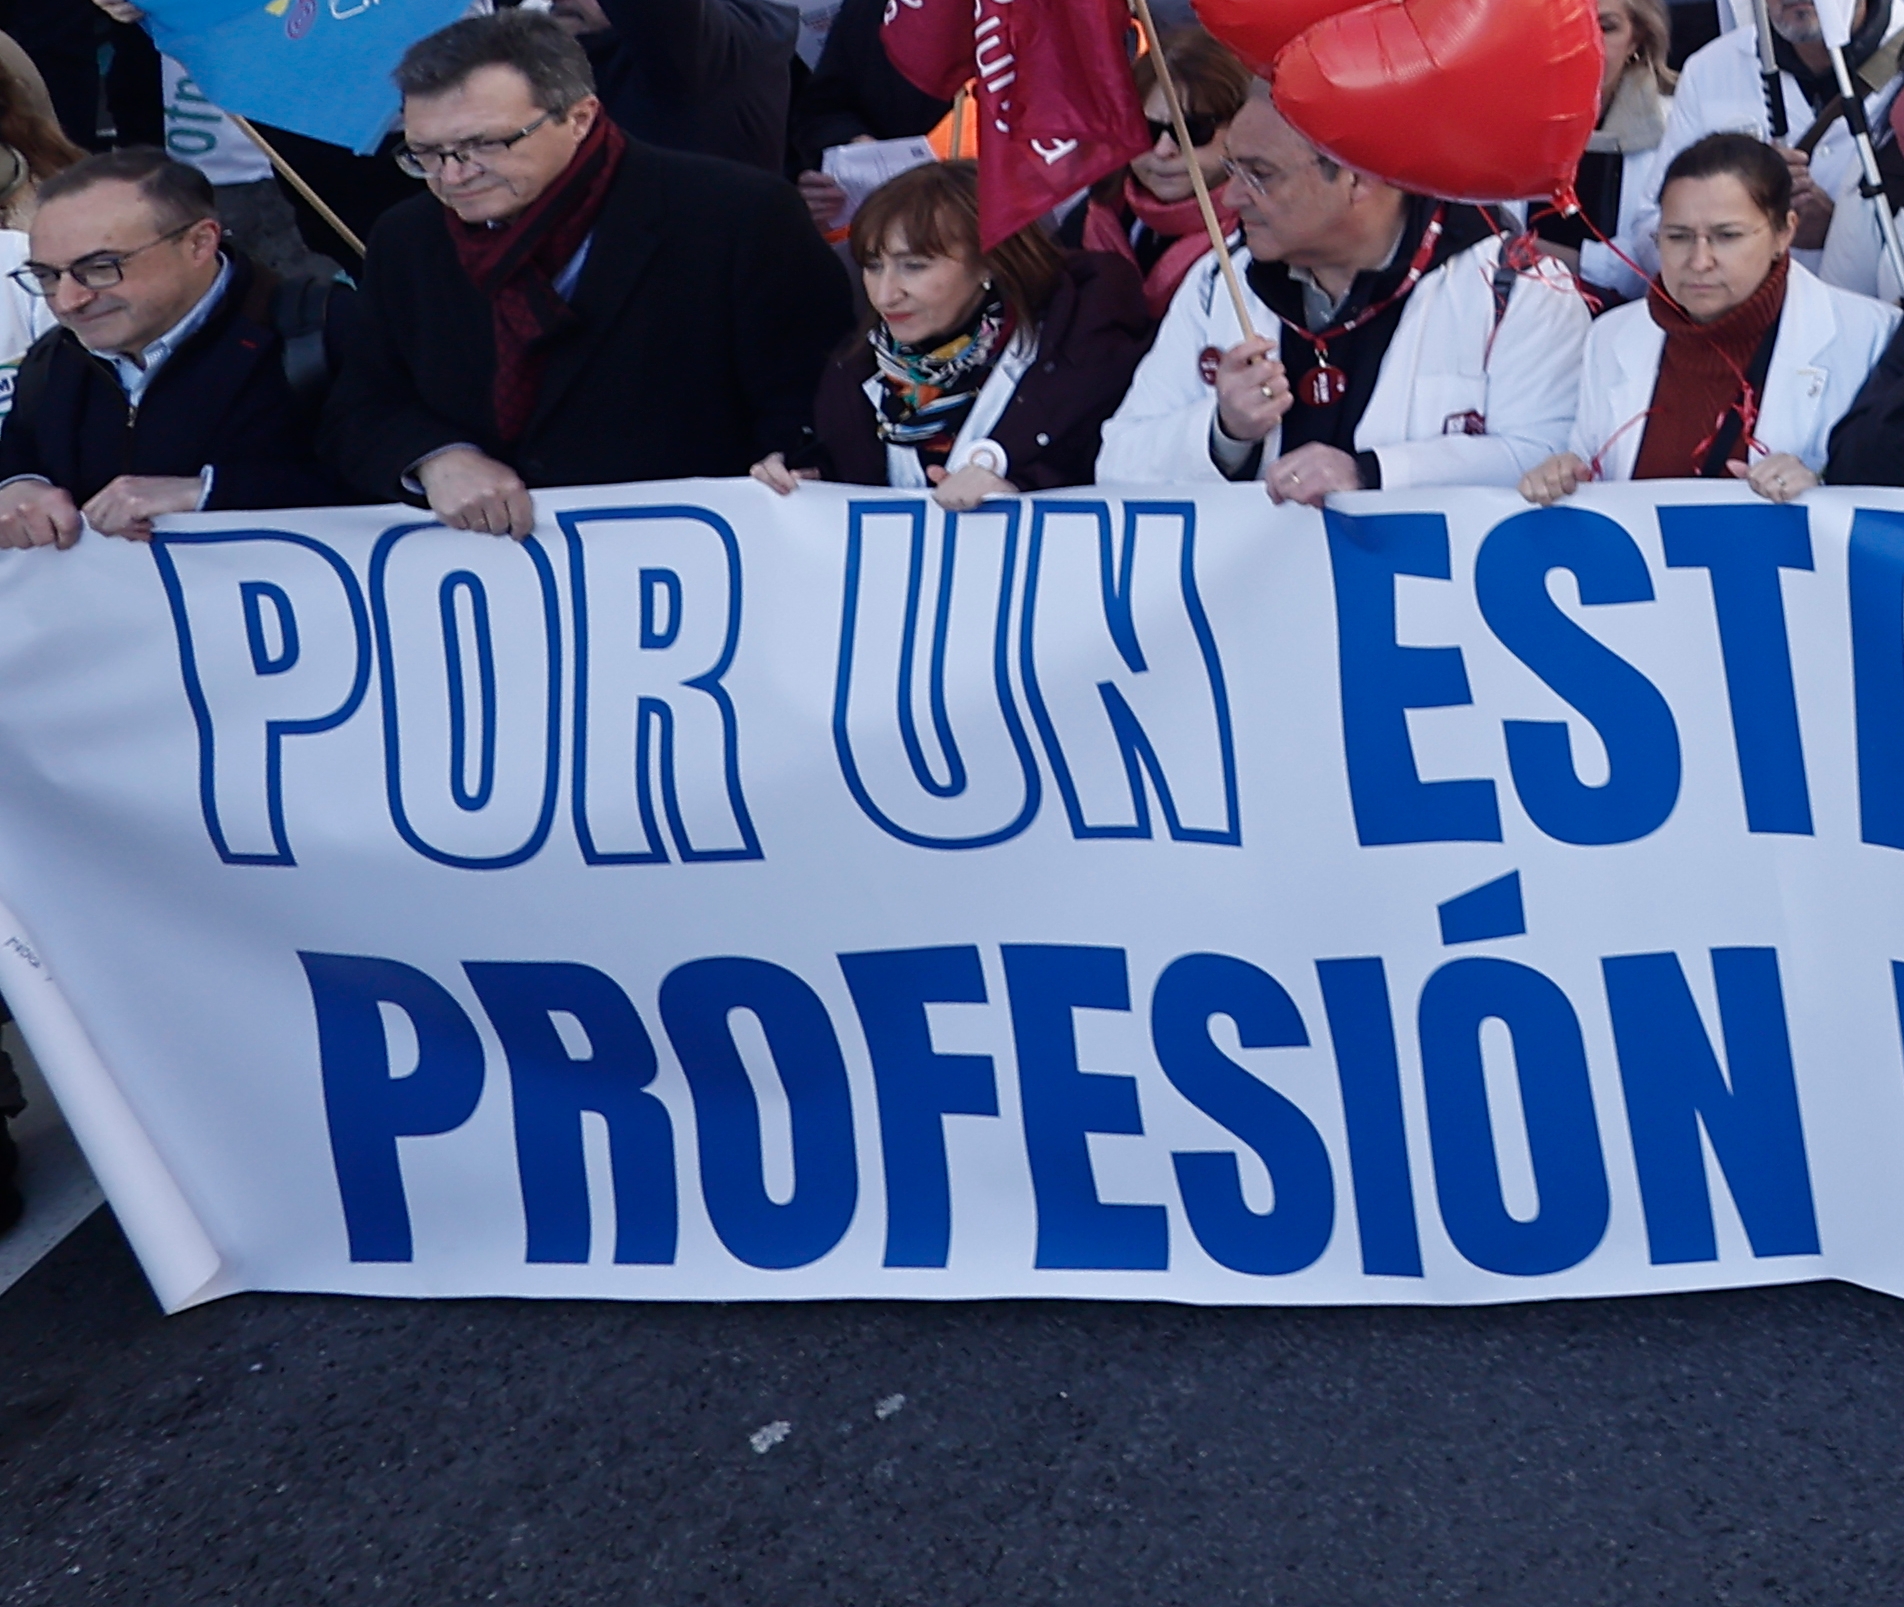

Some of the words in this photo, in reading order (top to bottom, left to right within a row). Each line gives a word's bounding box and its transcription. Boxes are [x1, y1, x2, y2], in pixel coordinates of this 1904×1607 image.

[150, 504, 764, 869] POR
[832, 499, 1243, 851] UN
[296, 868, 1822, 1280] PROFESIÓN
